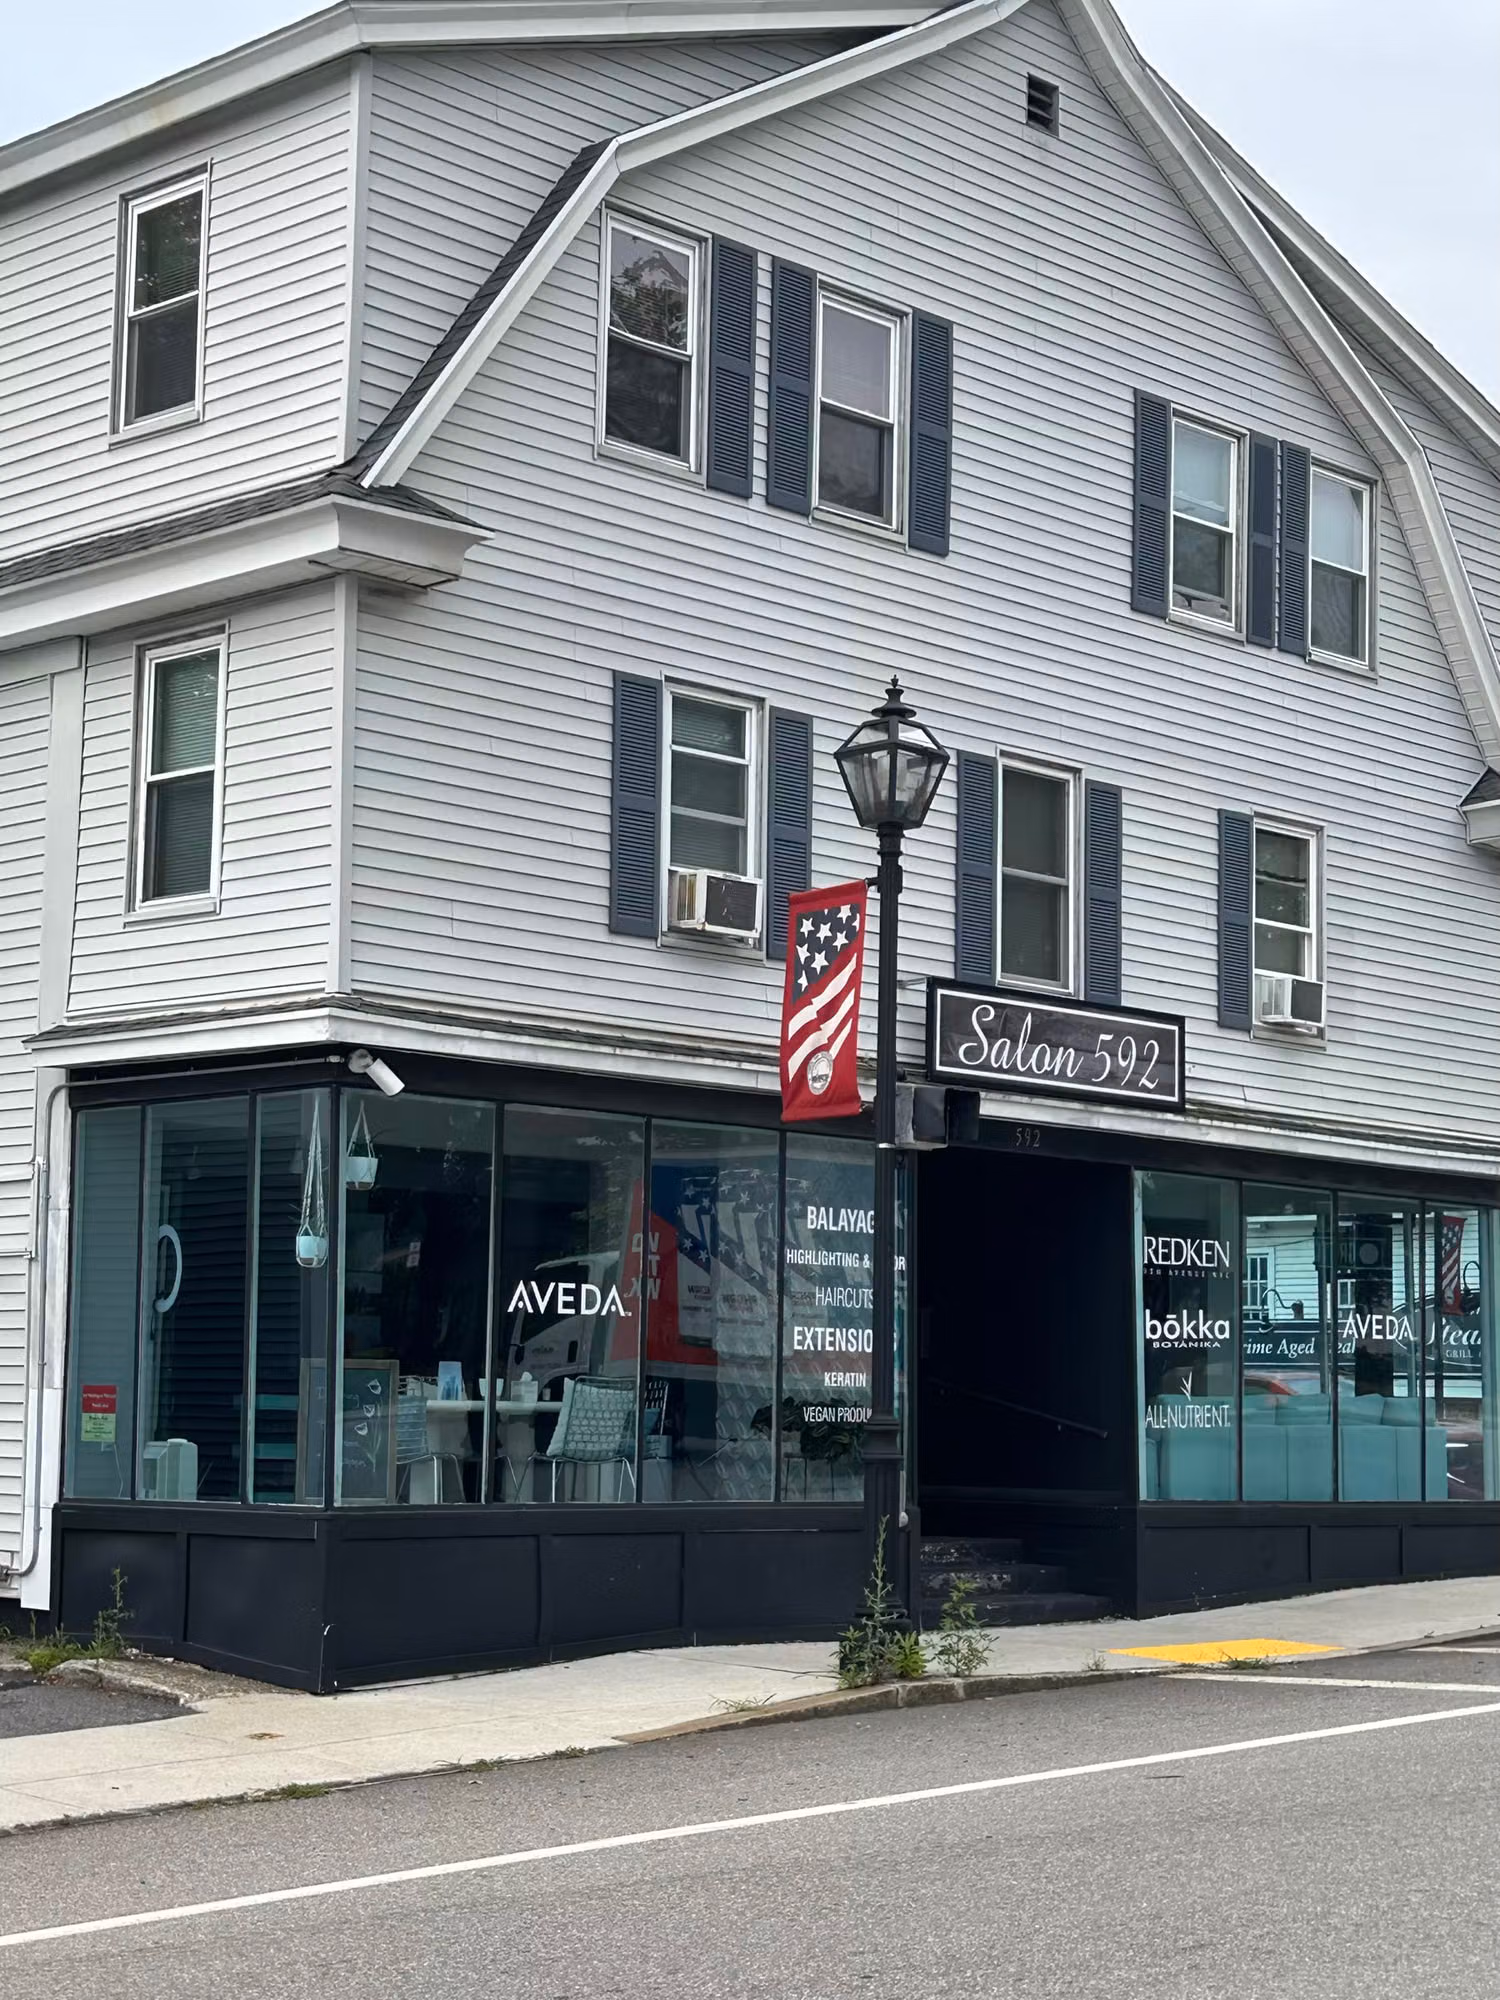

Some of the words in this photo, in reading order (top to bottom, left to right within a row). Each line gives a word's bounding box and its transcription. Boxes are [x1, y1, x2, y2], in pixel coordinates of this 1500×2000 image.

[958, 1004, 1084, 1078] Salon
[1091, 1033, 1160, 1090] 592
[1016, 1127, 1040, 1147] 592
[807, 1205, 875, 1234] BALAYAG
[786, 1248, 860, 1268] HIGHLIGHTING
[862, 1253, 871, 1269] &
[1143, 1236, 1230, 1268] REDKEN
[507, 1280, 626, 1317] AVEDA
[1342, 1311, 1415, 1341] AVEDA
[793, 1326, 874, 1353] EXTENSIO
[1277, 1337, 1315, 1359] Aged
[1446, 1349, 1474, 1358] GRILL
[824, 1371, 867, 1388] KERATIN
[803, 1406, 836, 1423] VEGAN
[837, 1407, 873, 1423] PRODU
